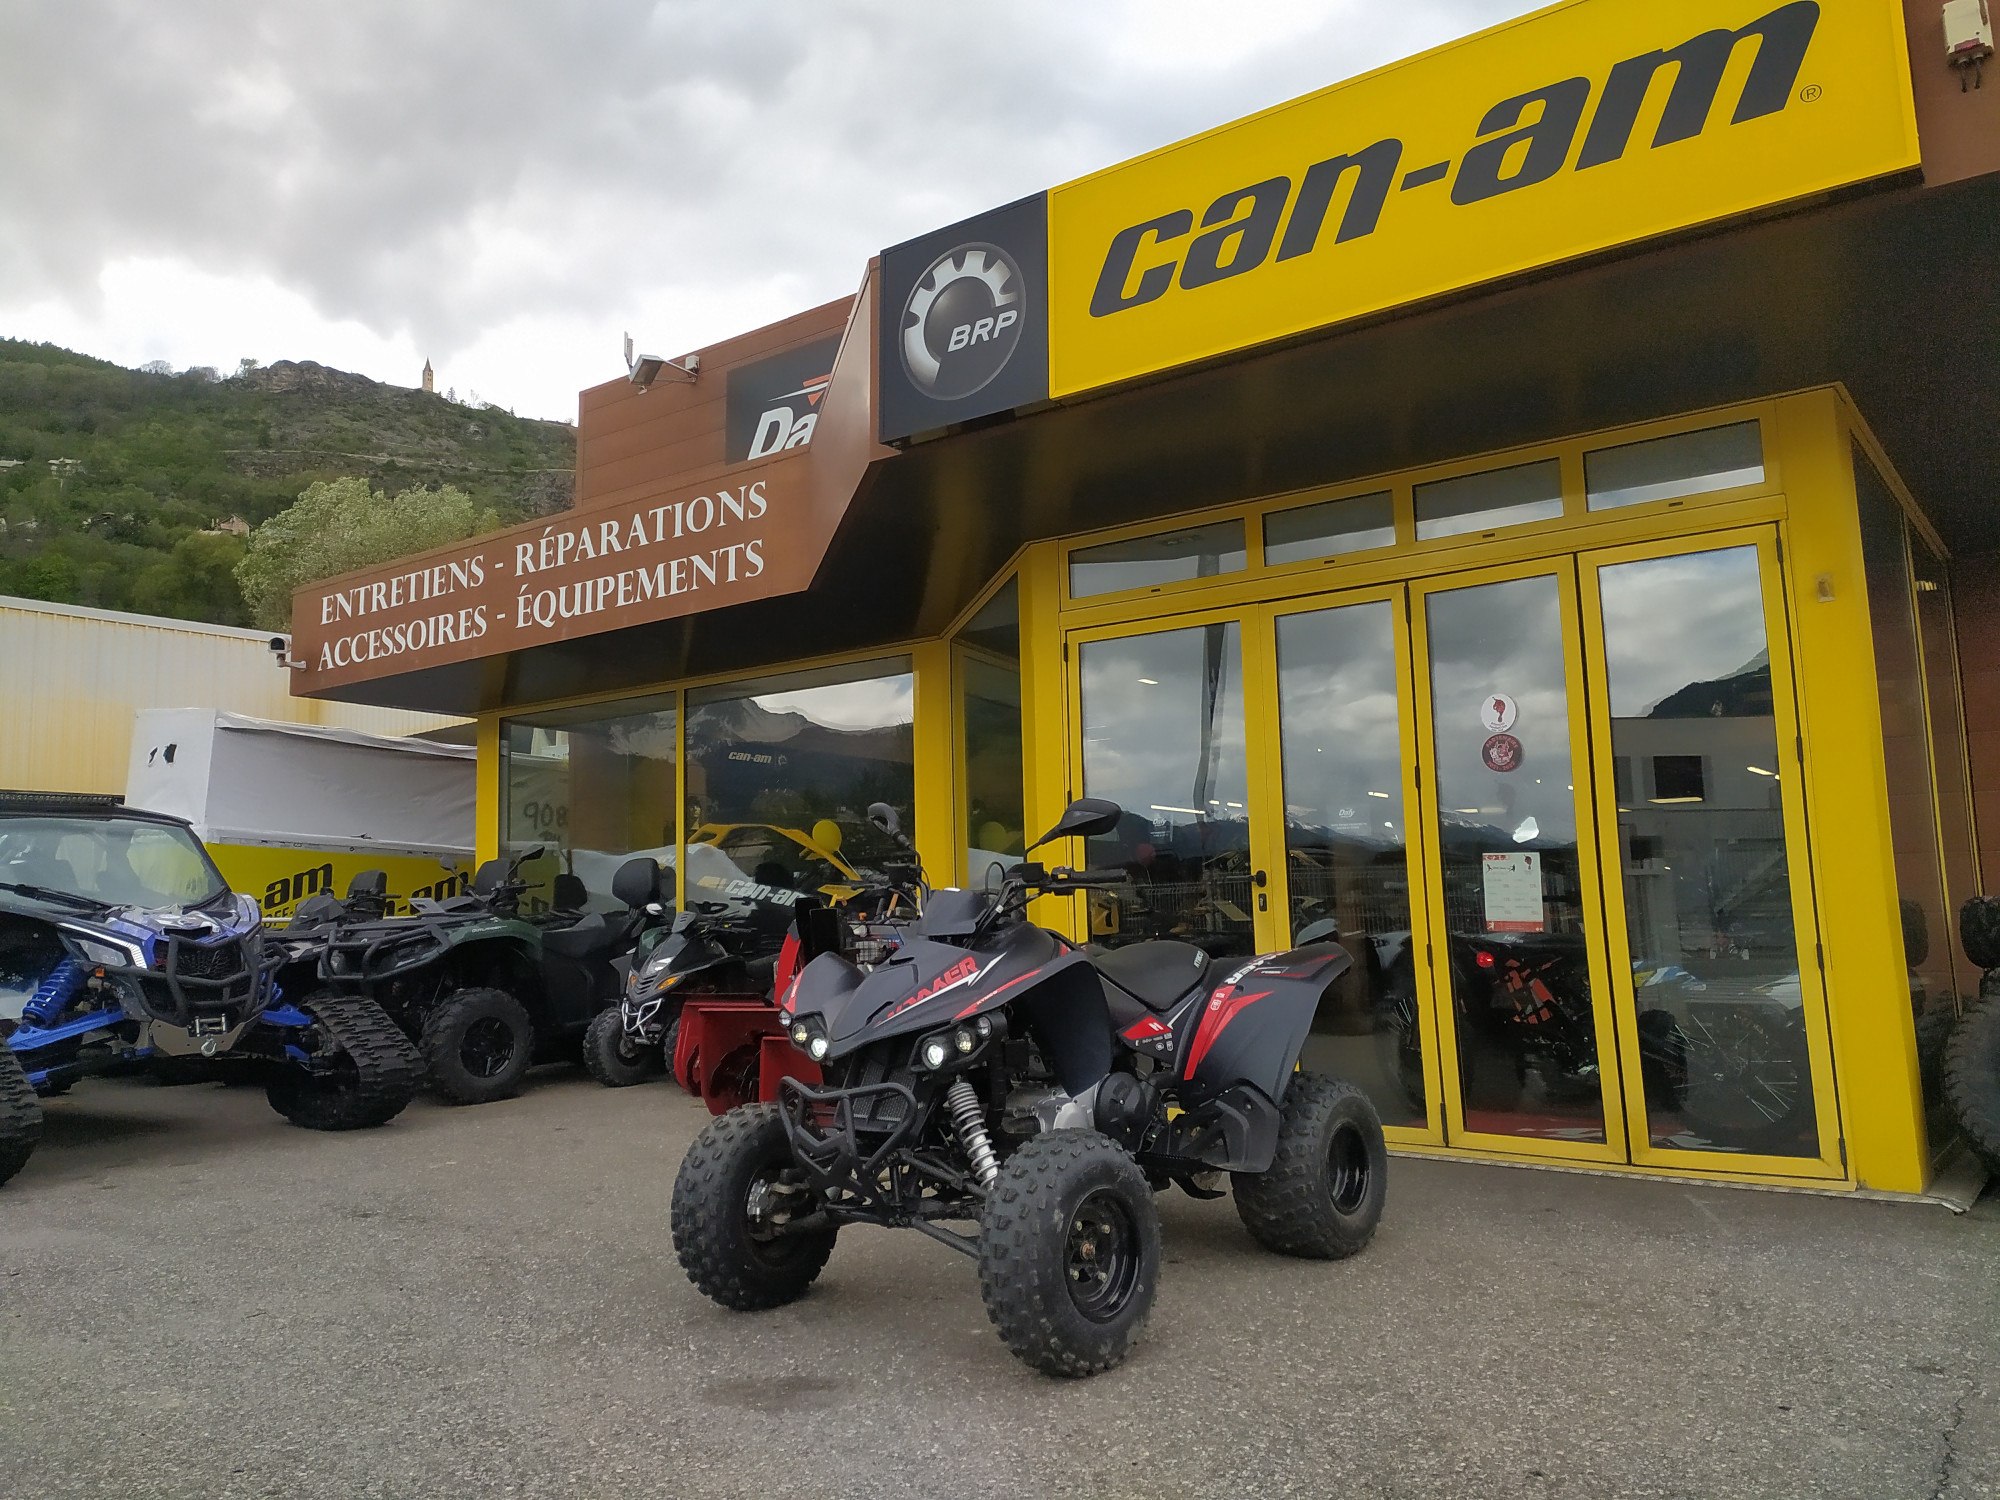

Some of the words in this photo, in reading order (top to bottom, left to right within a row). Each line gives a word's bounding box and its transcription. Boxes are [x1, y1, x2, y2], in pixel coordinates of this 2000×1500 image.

[947, 309, 1018, 353] BRP
[747, 406, 818, 461] Da
[320, 554, 484, 625] ENTRETIENS
[514, 480, 767, 577] RÉPARATIONS
[317, 604, 487, 672] ACCESSOIRES
[515, 539, 764, 629] ÉQUIPEMENTS
[728, 751, 772, 764] can-am
[264, 906, 294, 929] OFF-
